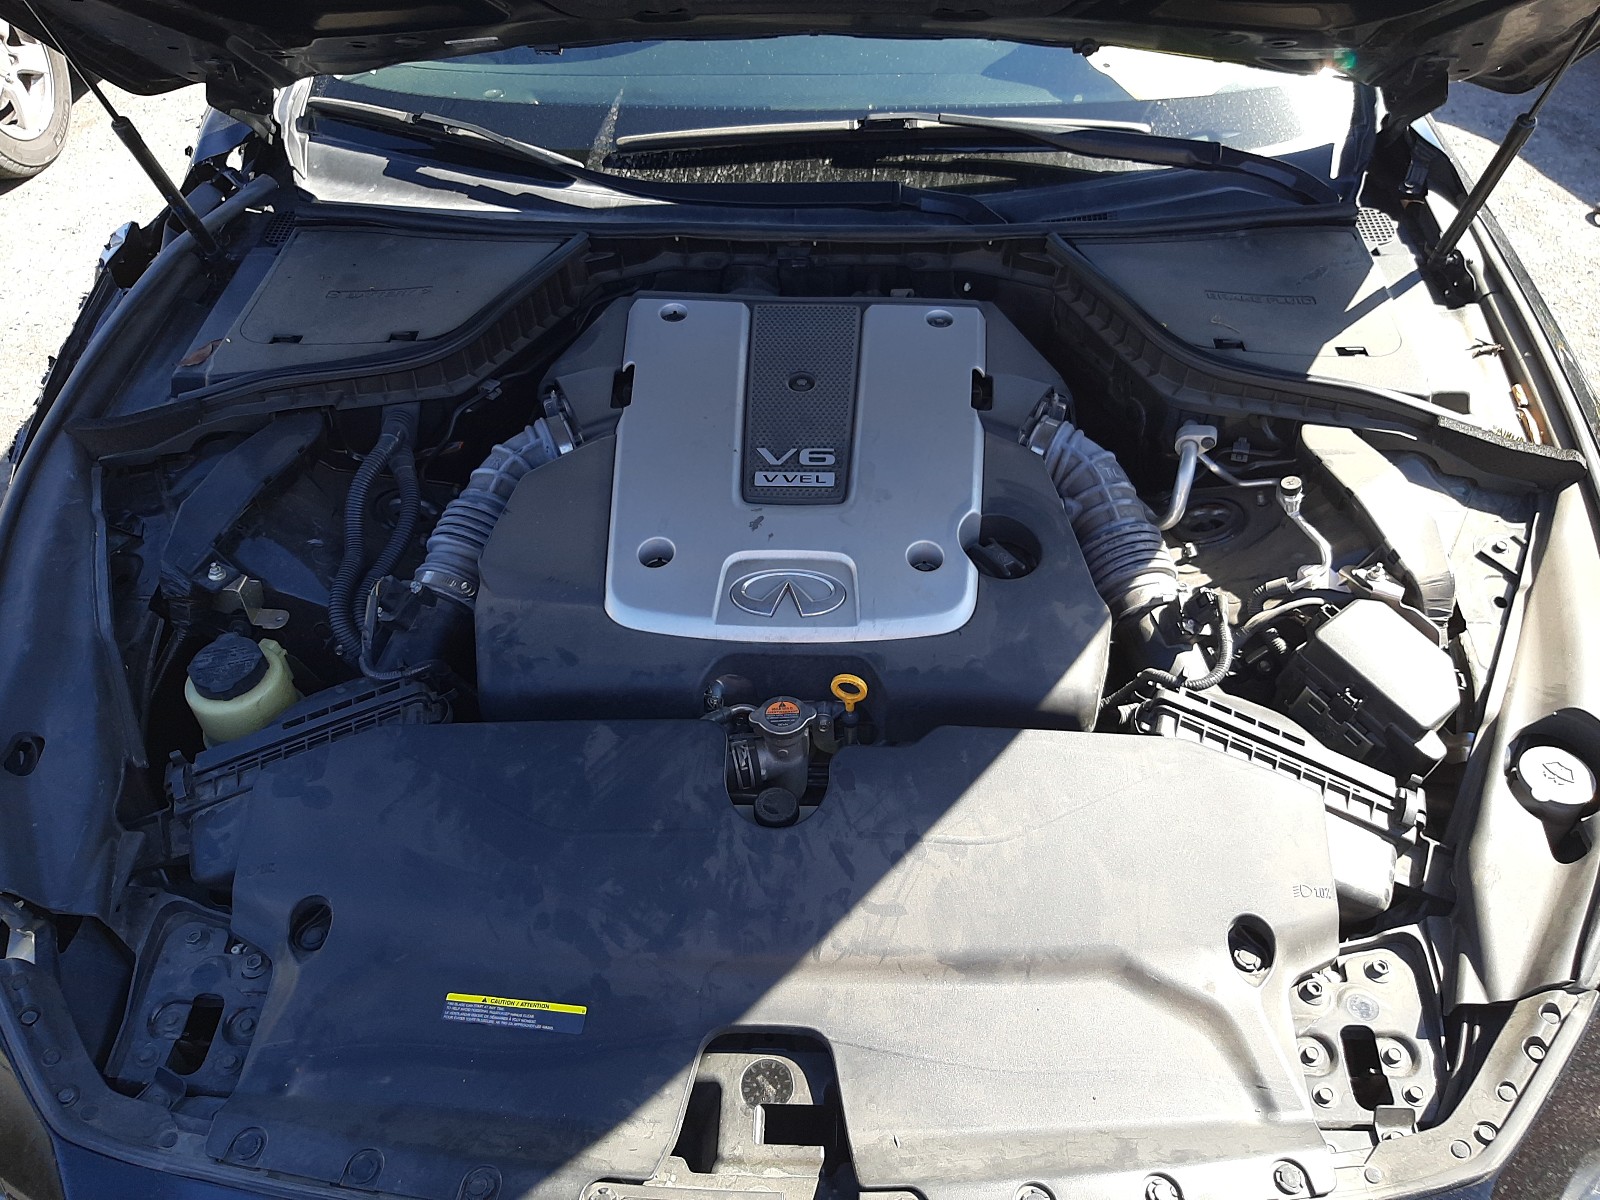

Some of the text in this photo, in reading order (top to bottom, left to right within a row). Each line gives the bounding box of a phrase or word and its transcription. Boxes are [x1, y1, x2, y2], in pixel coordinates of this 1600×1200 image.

[756, 447, 836, 466] V6
[763, 474, 827, 484] VVEL
[490, 998, 516, 1006] CAUTION
[520, 1001, 550, 1010] ATTENTION
